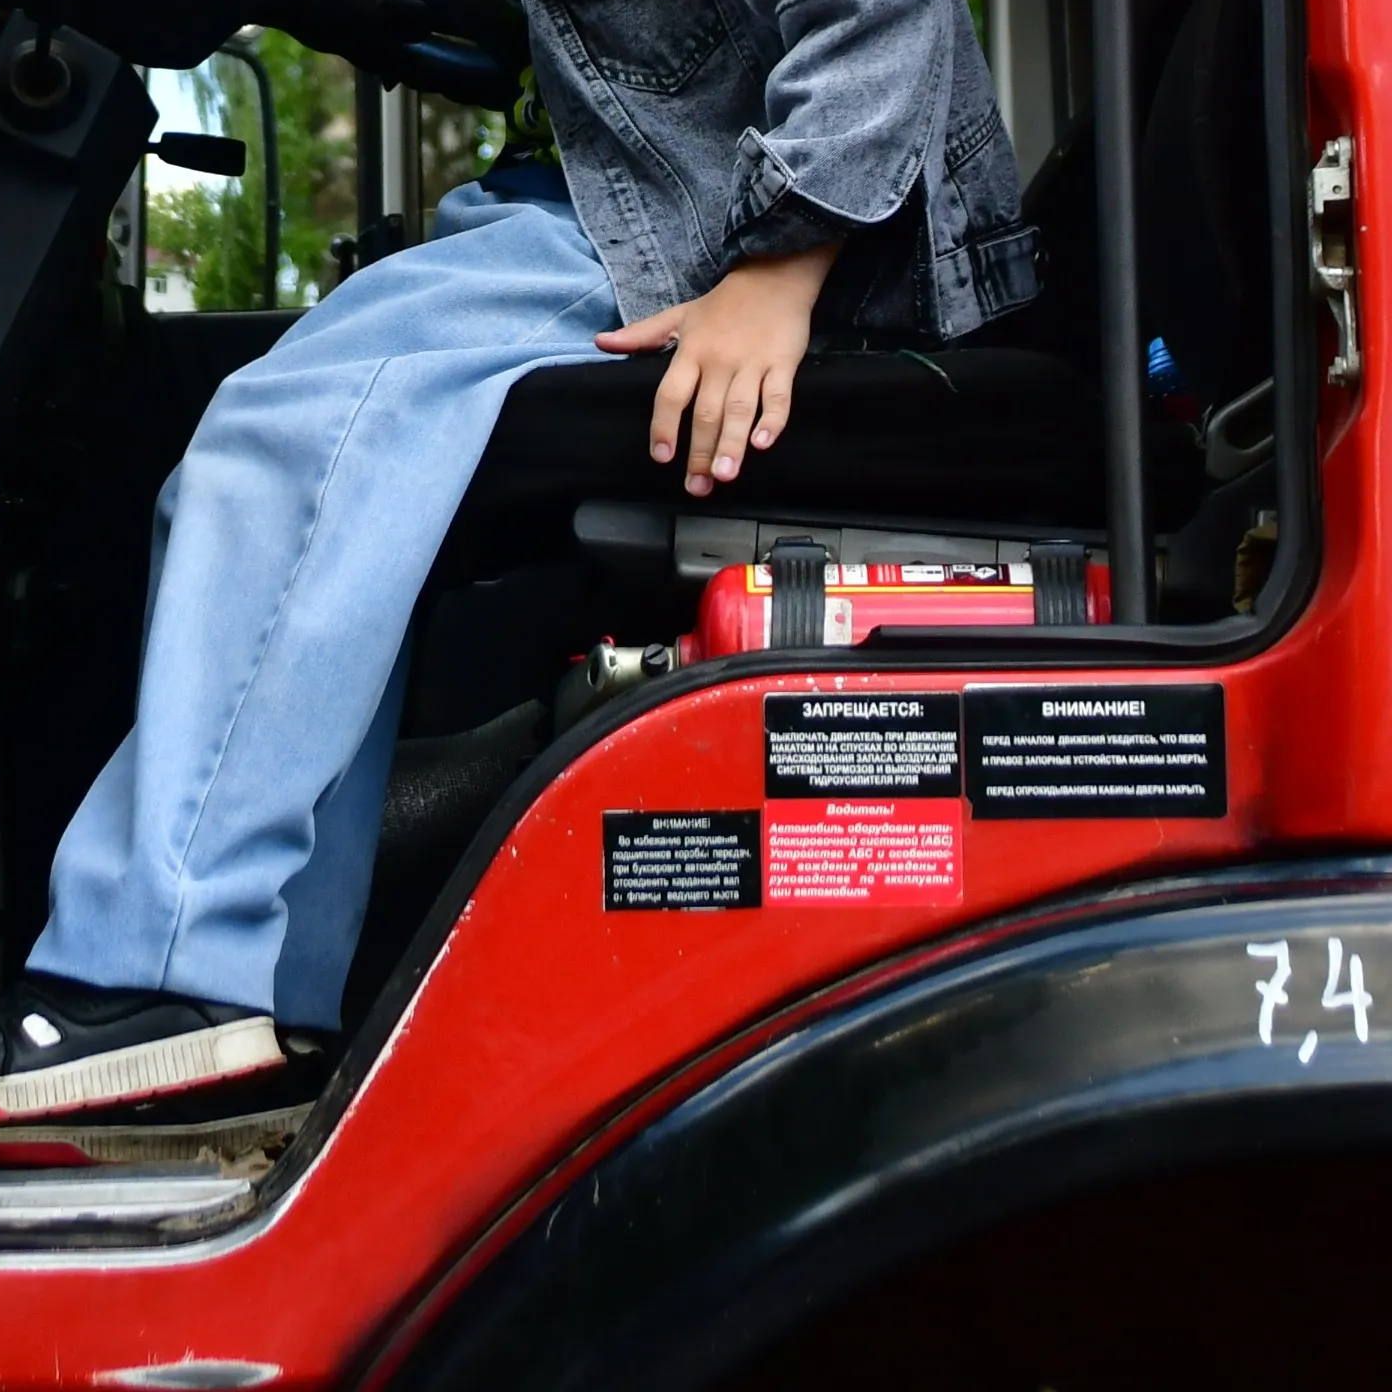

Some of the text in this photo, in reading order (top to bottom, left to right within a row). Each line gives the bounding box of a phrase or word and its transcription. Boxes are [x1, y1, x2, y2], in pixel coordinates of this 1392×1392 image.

[802, 702, 924, 719] ЗАПРЕЩАЕТСЯ:
[1042, 700, 1146, 717] ВНИМАНИЕ!
[770, 732, 957, 742] ВЫКЛЮЧАТЬ ДВИГАТЕЛЬ ПРИ ДВИЖЕНИИ
[771, 742, 955, 753] НАКАТОМ И НА СПУСКАХ ВО ИЗБЕЖАНИЕ
[777, 764, 951, 775] СИСТЕМЫ ТОРМОЗОВ И ВЫКЛЮЧЕНИЯ
[809, 775, 918, 786] ГИДРОУСИЛИТЕЛЯ РУЛЯ
[826, 803, 895, 816] Водитель!
[769, 822, 844, 833] Автомобиль
[1246, 937, 1373, 1064] 7,4
